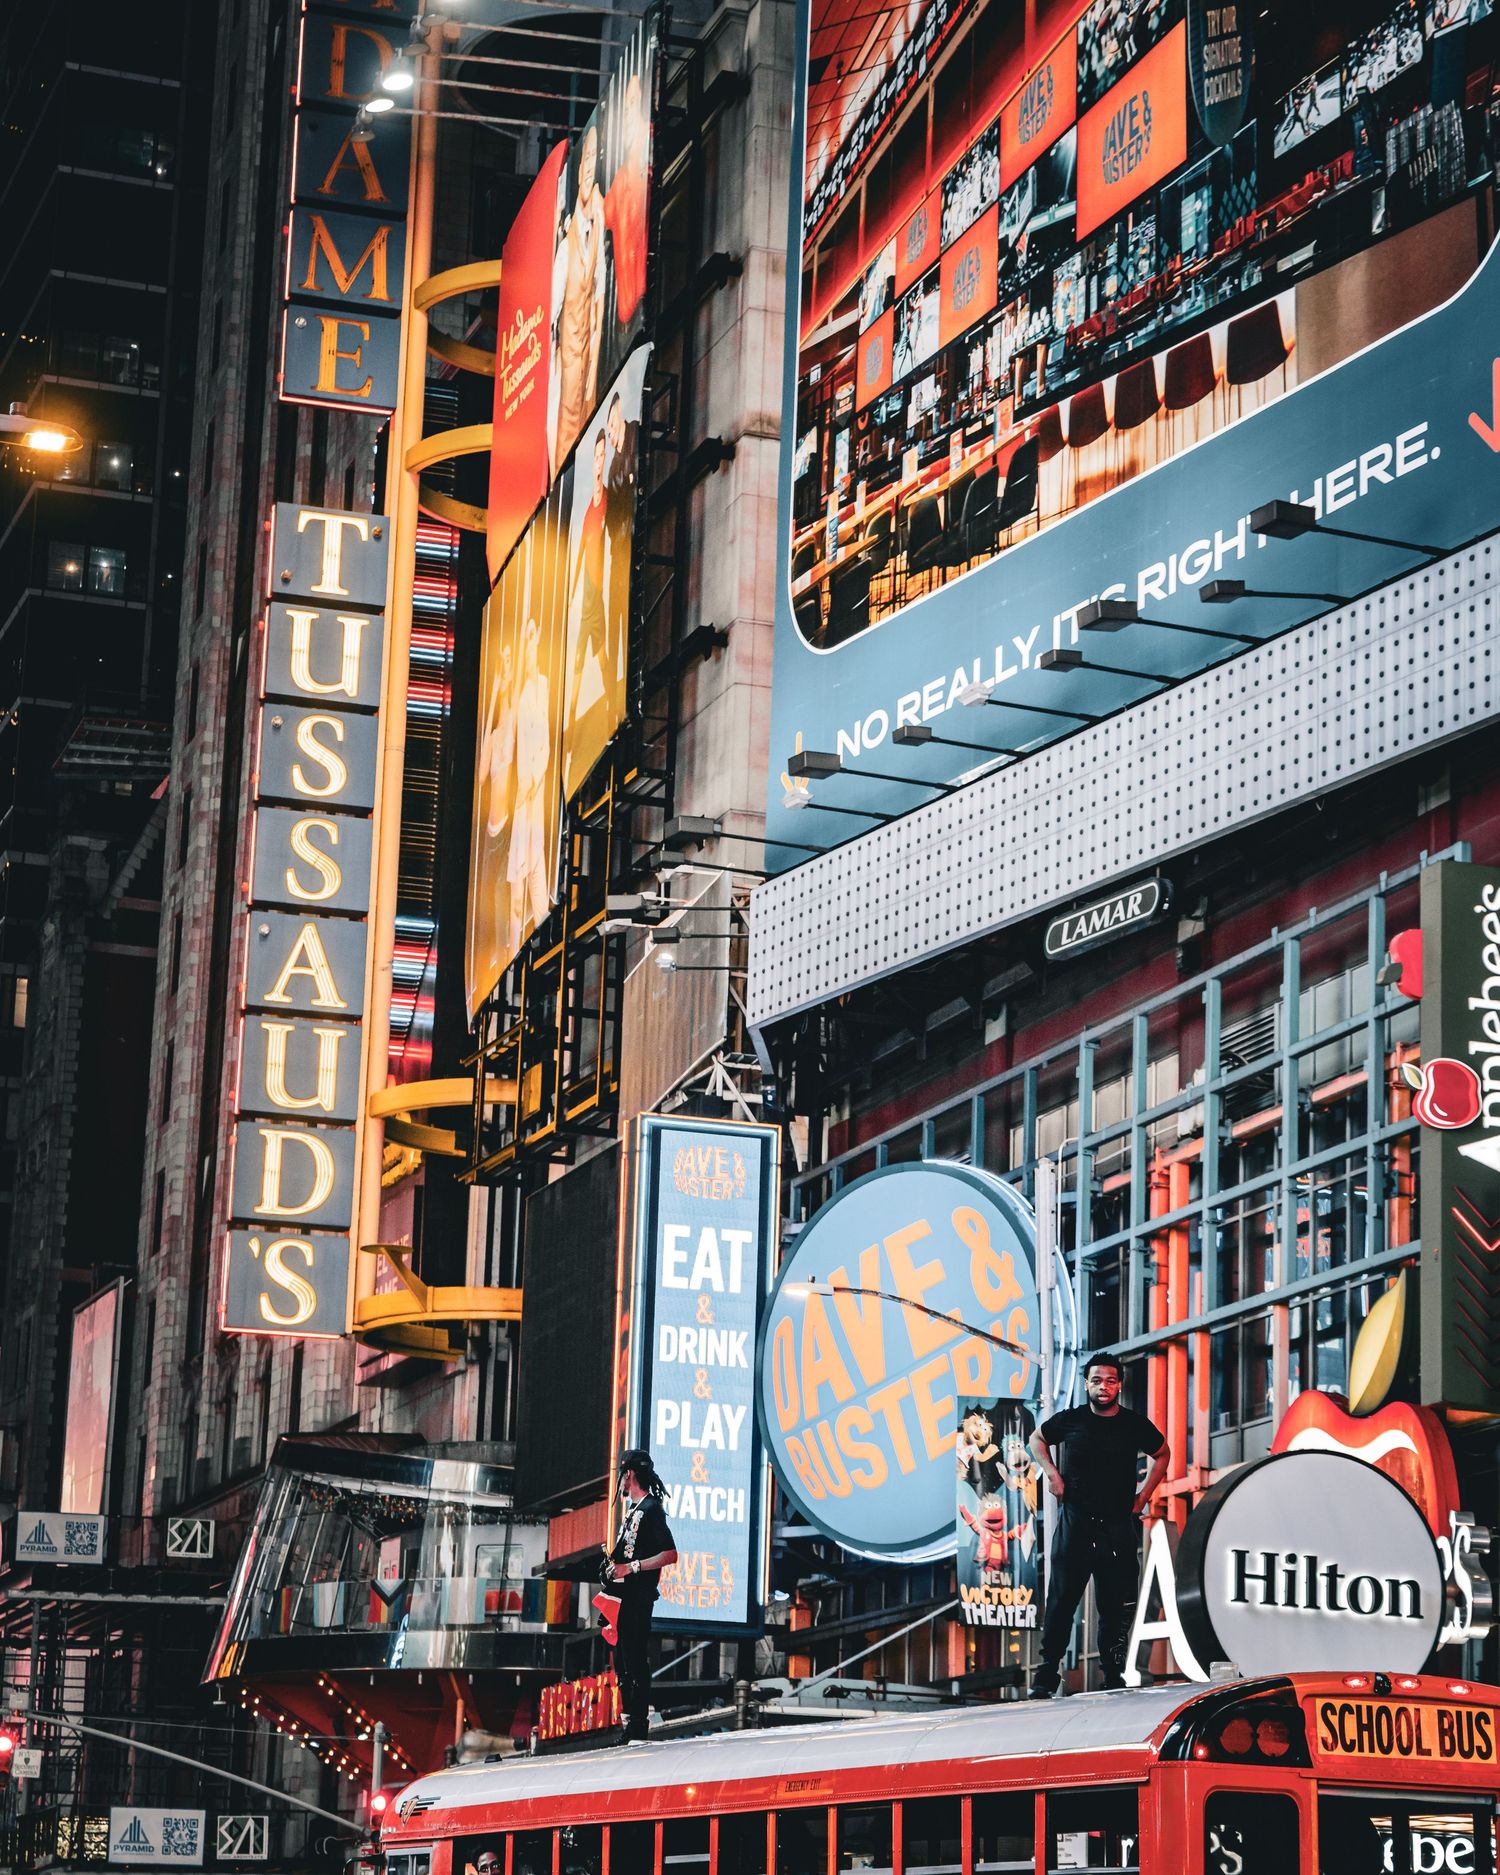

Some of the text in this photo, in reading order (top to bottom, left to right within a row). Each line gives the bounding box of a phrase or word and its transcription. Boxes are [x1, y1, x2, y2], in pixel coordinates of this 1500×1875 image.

[298, 0, 398, 398] DAME
[837, 709, 889, 763] NO
[896, 625, 1042, 730] REALLY,
[1289, 421, 1441, 520] HERE.
[248, 510, 371, 1326] TUSSAUD'S
[1061, 892, 1142, 945] LAMAR
[662, 1224, 752, 1293] EAT
[695, 1293, 715, 1325] &
[773, 1206, 1024, 1433] DAVE &
[658, 1325, 748, 1368] DRINK
[692, 1367, 713, 1399] &
[785, 1306, 1030, 1500] BUSTER'S
[655, 1399, 747, 1450] PLAY
[690, 1451, 710, 1483] &
[20, 1544, 57, 1553] PYRAMID
[960, 1583, 1033, 1606] VICTORY
[981, 1570, 1013, 1586] NEW
[1230, 1549, 1424, 1620] Hilton
[961, 1601, 1037, 1628] THEATER
[1320, 1702, 1492, 1761] SCHOOL BUS
[113, 1844, 154, 1853] PYRAMID
